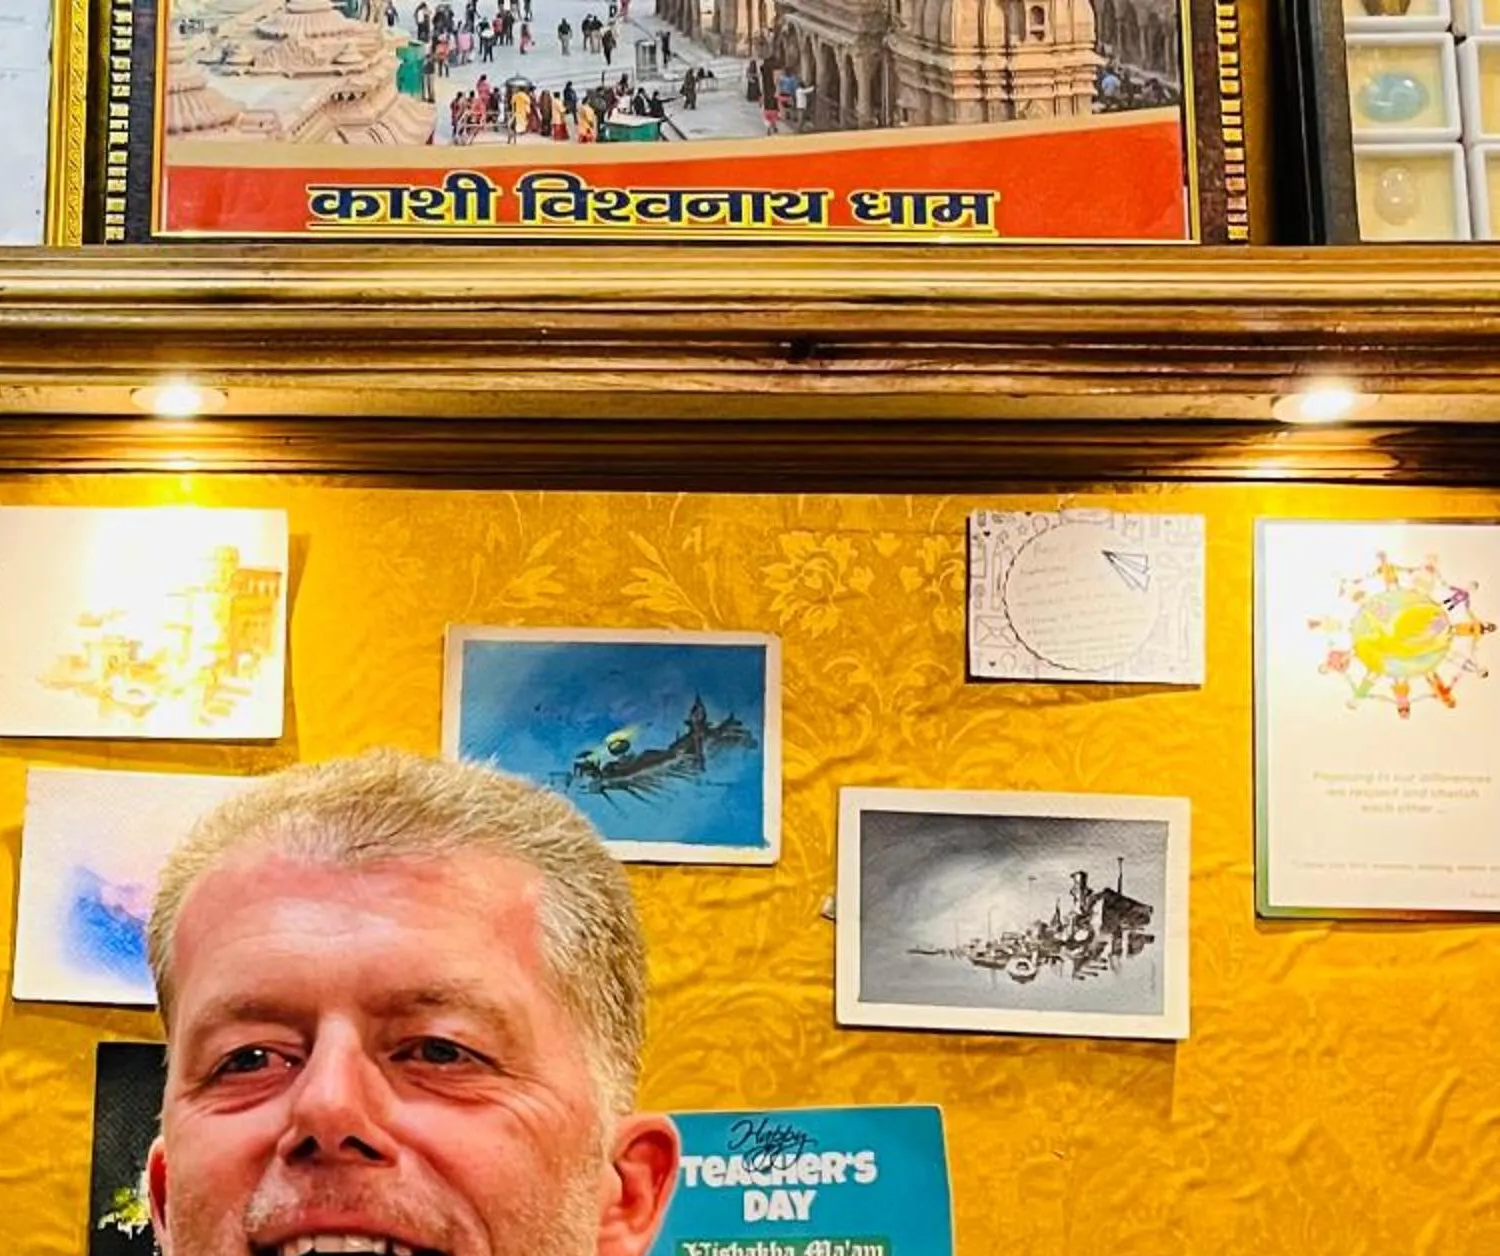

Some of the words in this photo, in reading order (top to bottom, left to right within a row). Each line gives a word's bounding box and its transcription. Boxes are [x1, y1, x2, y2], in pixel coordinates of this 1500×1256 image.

[307, 171, 497, 221] काशी
[848, 190, 996, 226] धाम
[743, 1189, 817, 1222] DAY
